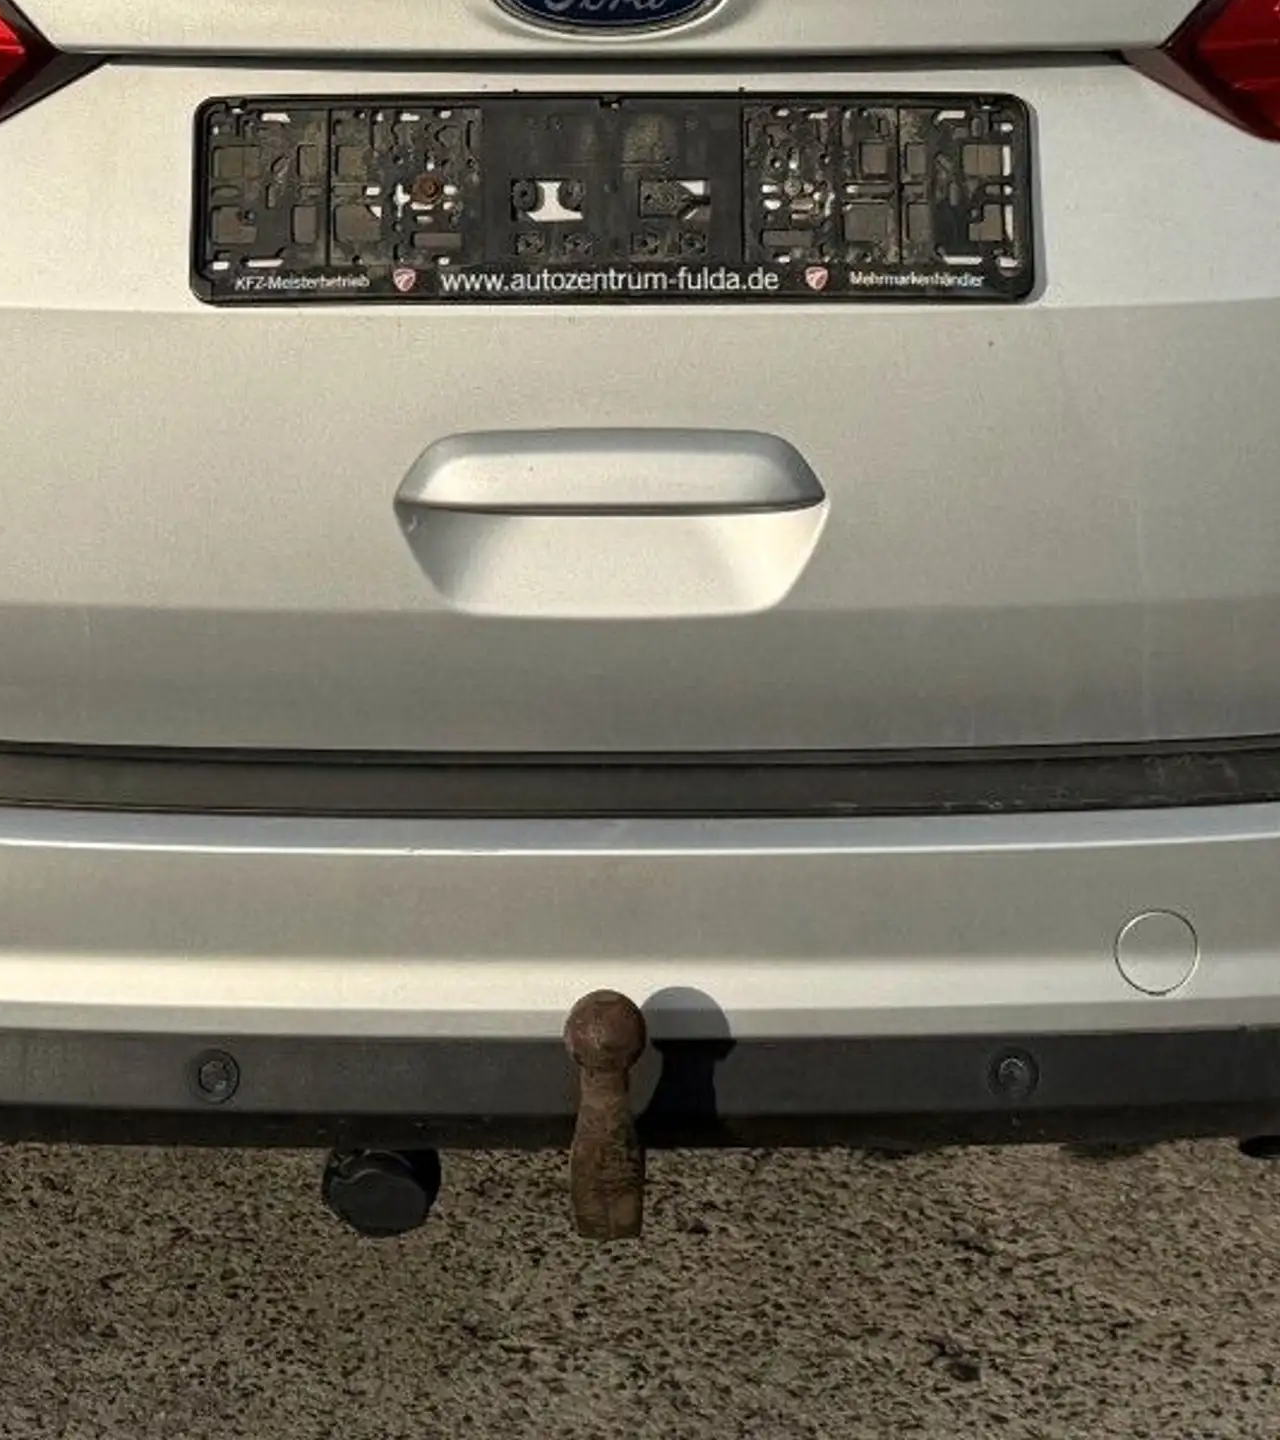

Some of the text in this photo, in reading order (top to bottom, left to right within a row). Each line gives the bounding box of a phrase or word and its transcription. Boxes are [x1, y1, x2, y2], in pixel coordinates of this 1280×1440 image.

[234, 267, 985, 292] KFZ-Meisterbetrieb www.autozentrum-fulda.de Mehrmarkenhändler
